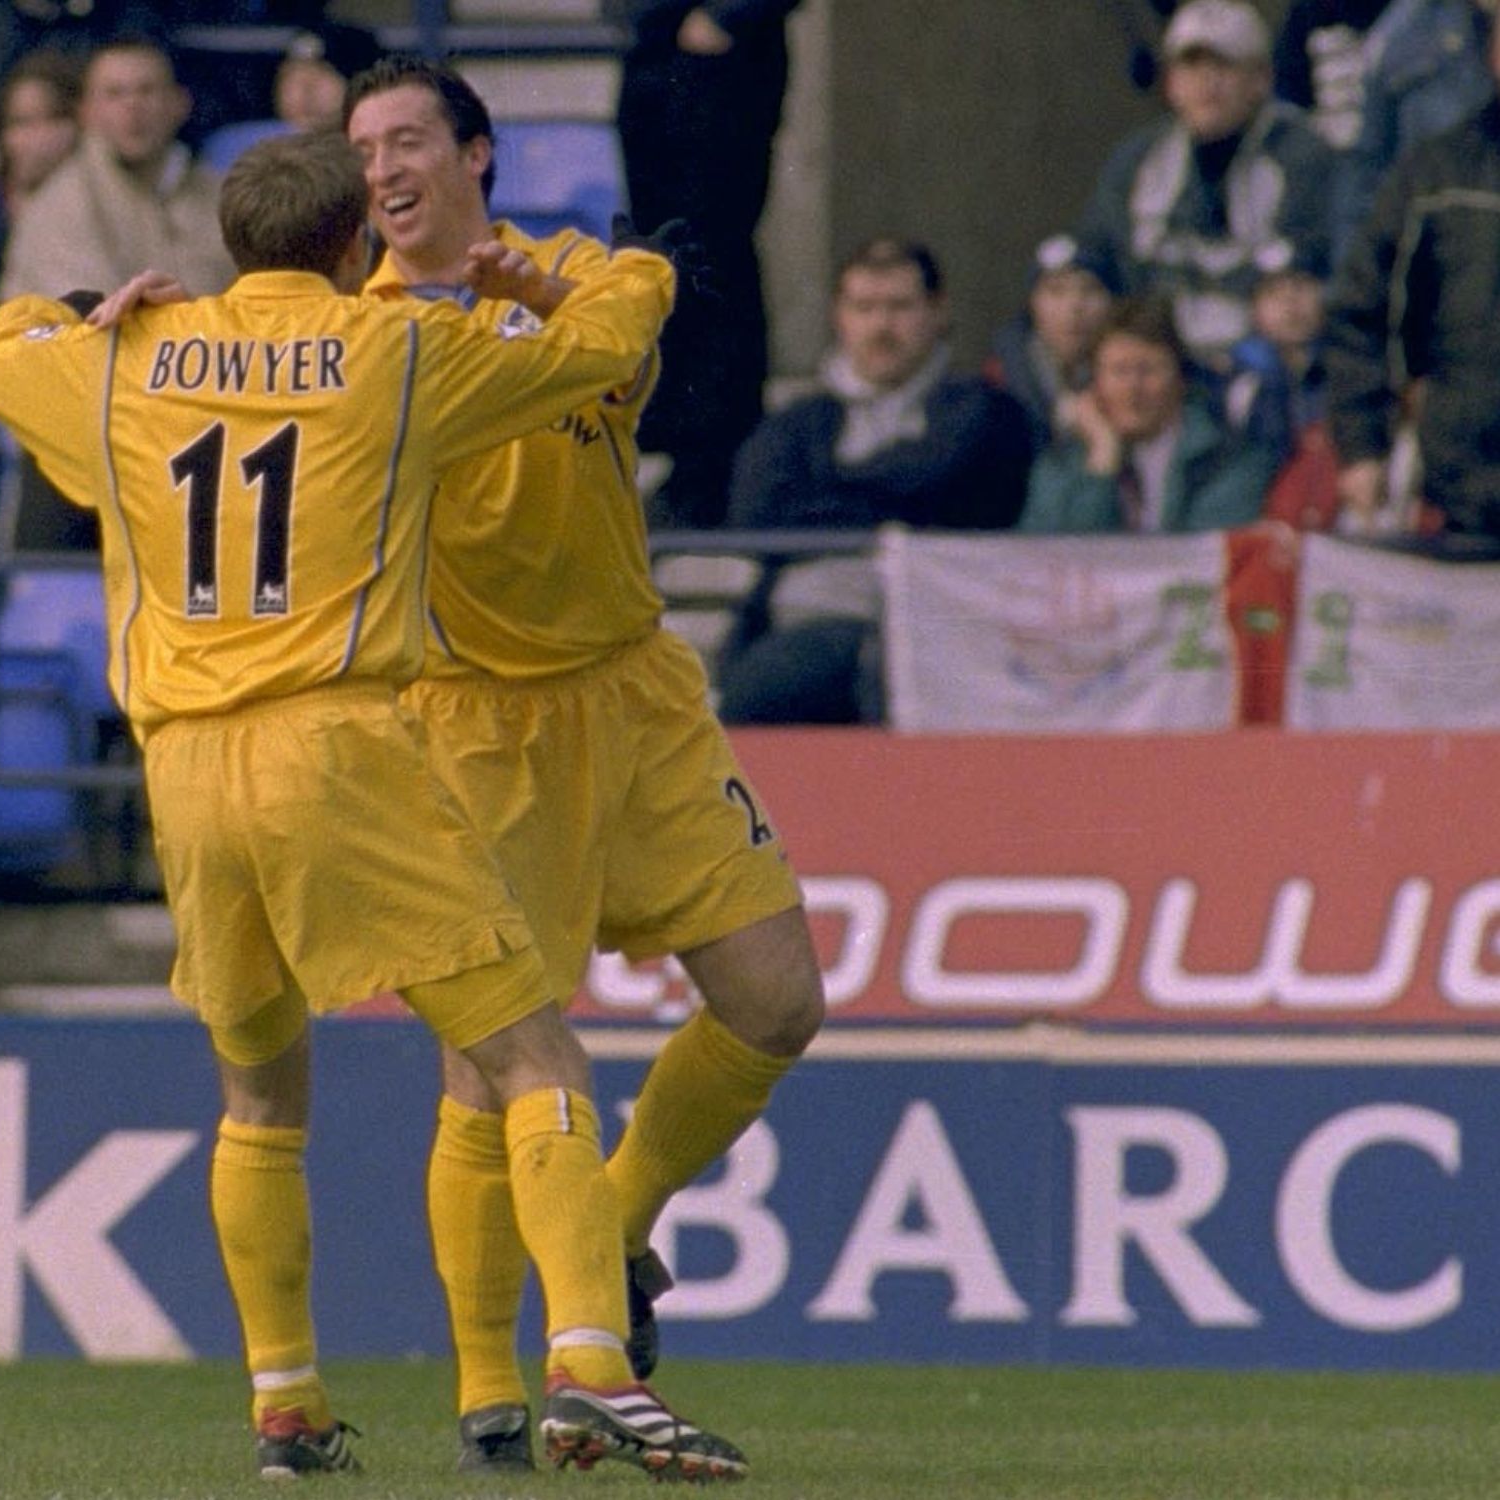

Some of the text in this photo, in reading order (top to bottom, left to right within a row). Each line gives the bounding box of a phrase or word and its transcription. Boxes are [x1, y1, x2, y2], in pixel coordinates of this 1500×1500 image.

[147, 338, 348, 393] BOWYER
[169, 420, 301, 617] 11
[618, 1101, 1463, 1332] BARC
